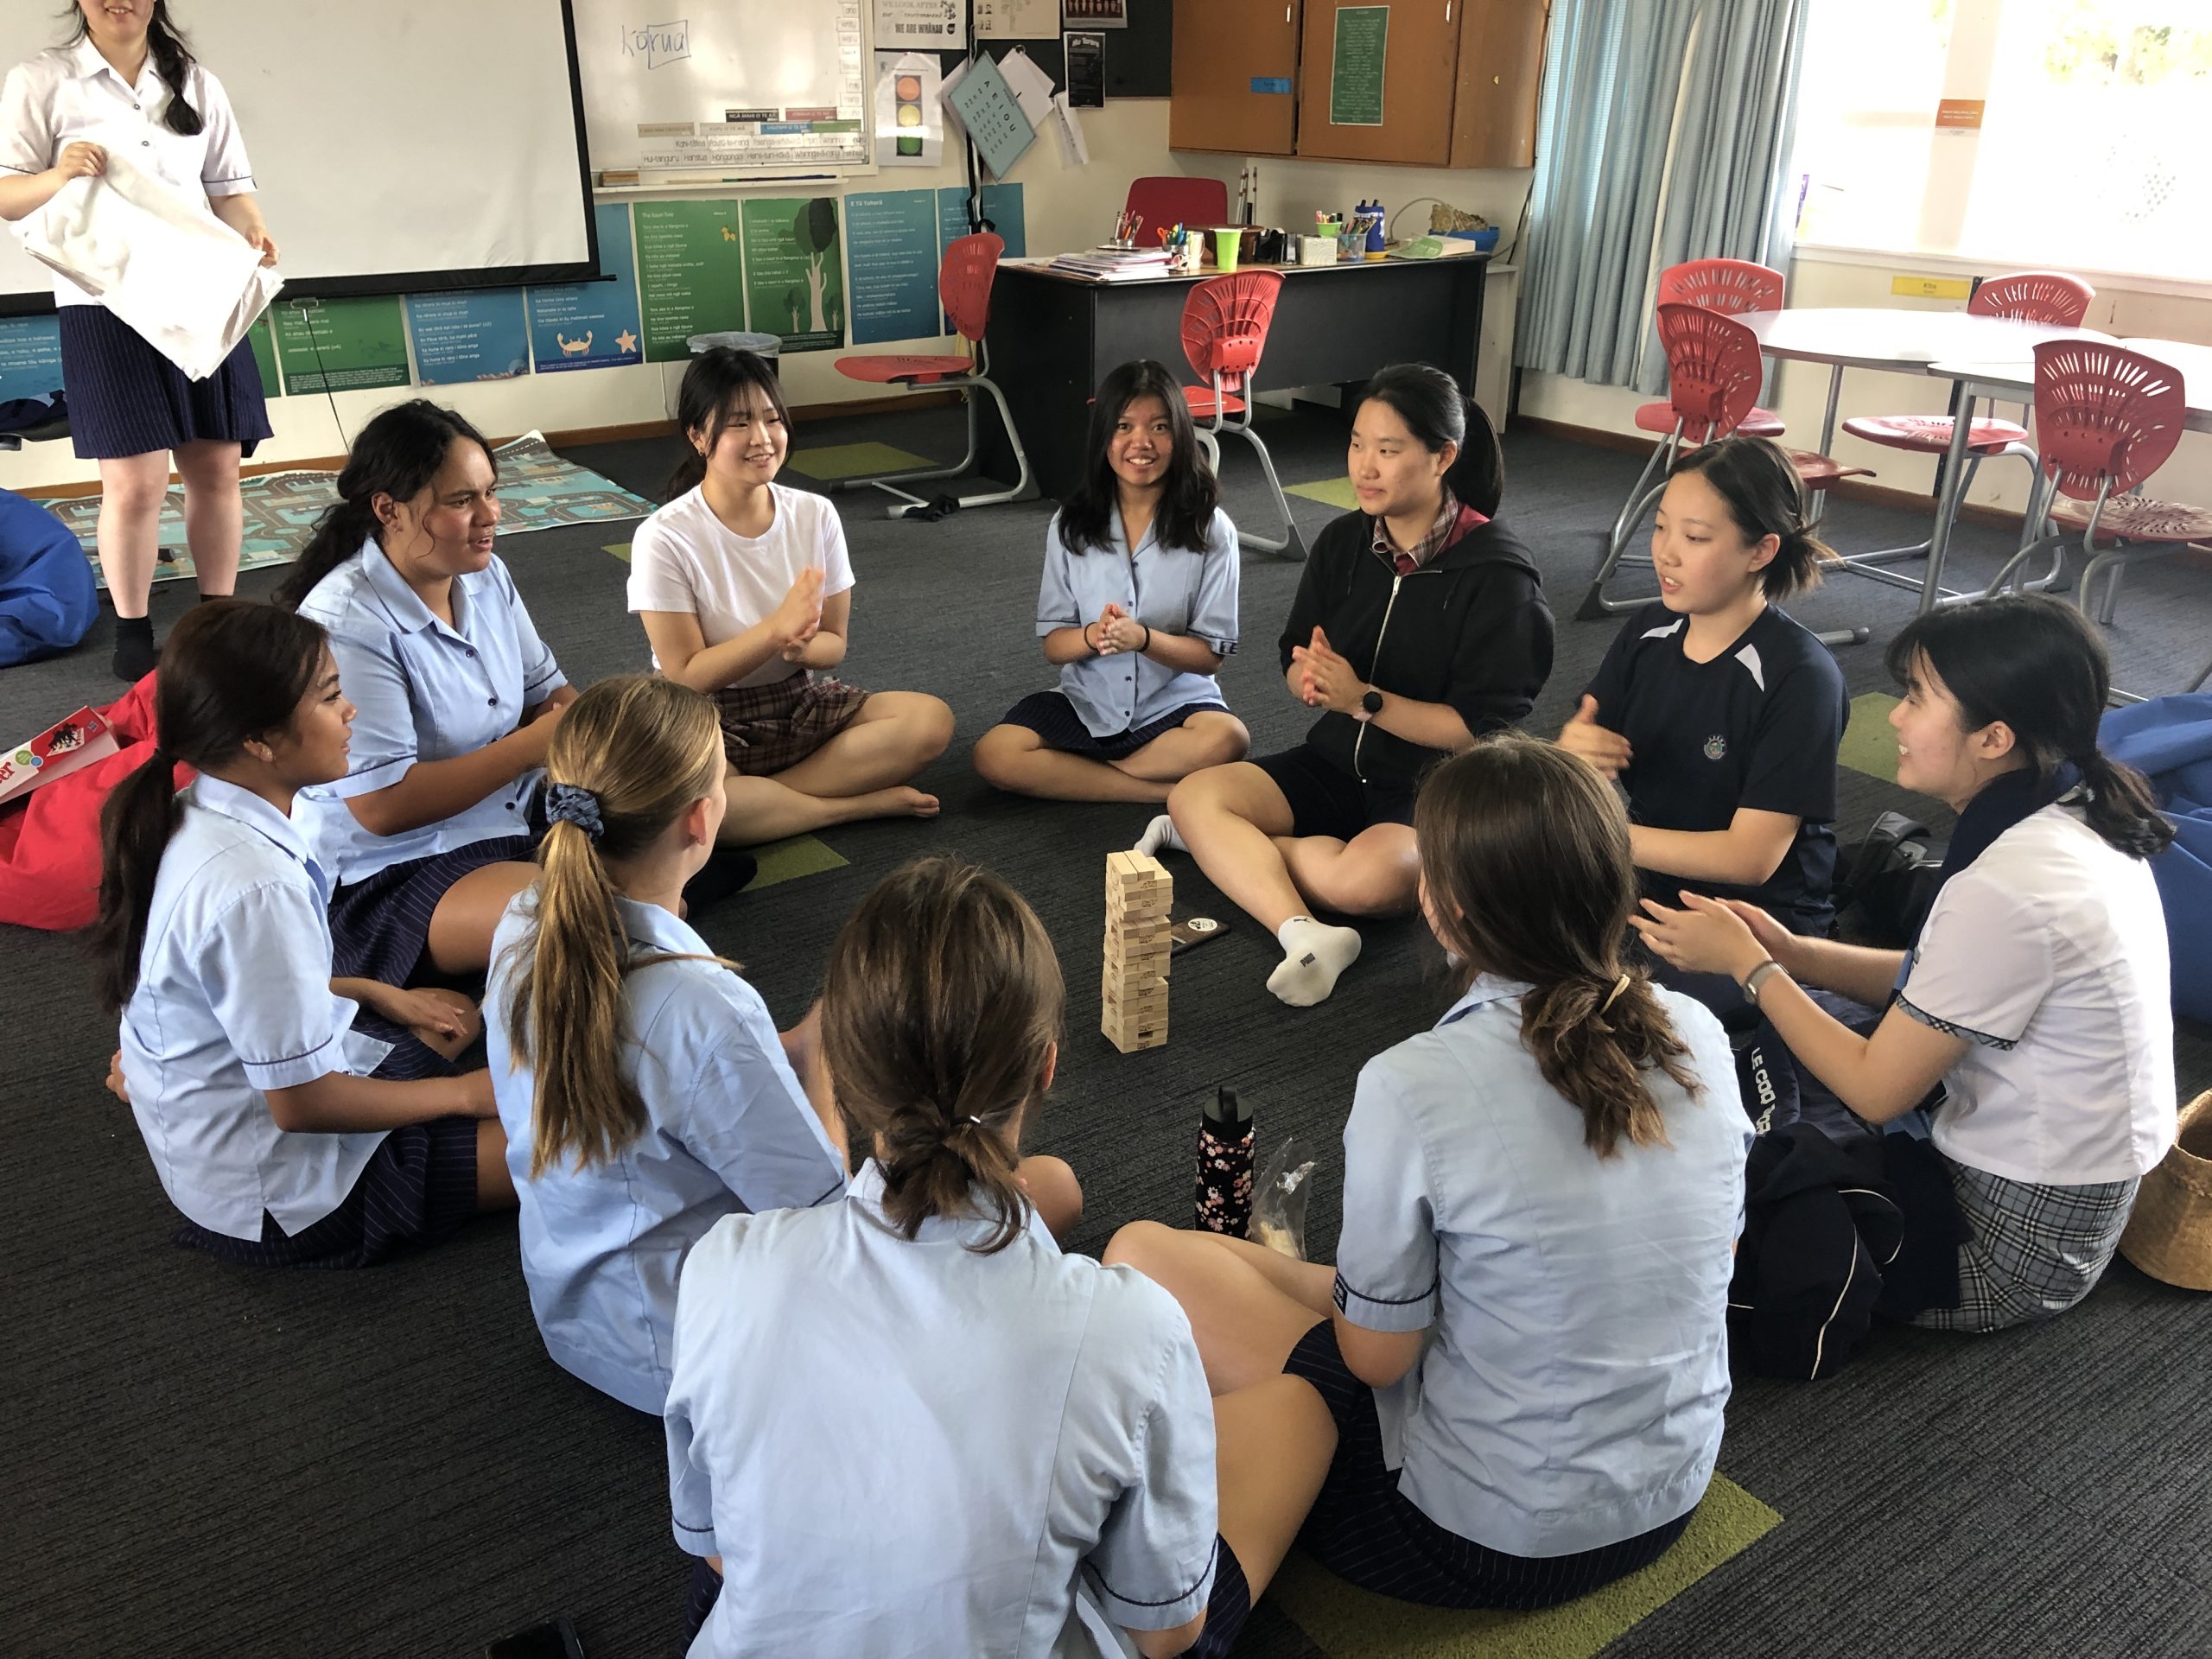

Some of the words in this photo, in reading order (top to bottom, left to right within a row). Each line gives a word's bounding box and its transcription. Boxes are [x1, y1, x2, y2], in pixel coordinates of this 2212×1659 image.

[895, 23, 905, 34] WE
[906, 23, 917, 34] ARE
[0, 761, 15, 784] er
[1751, 1046, 1764, 1071] LE
